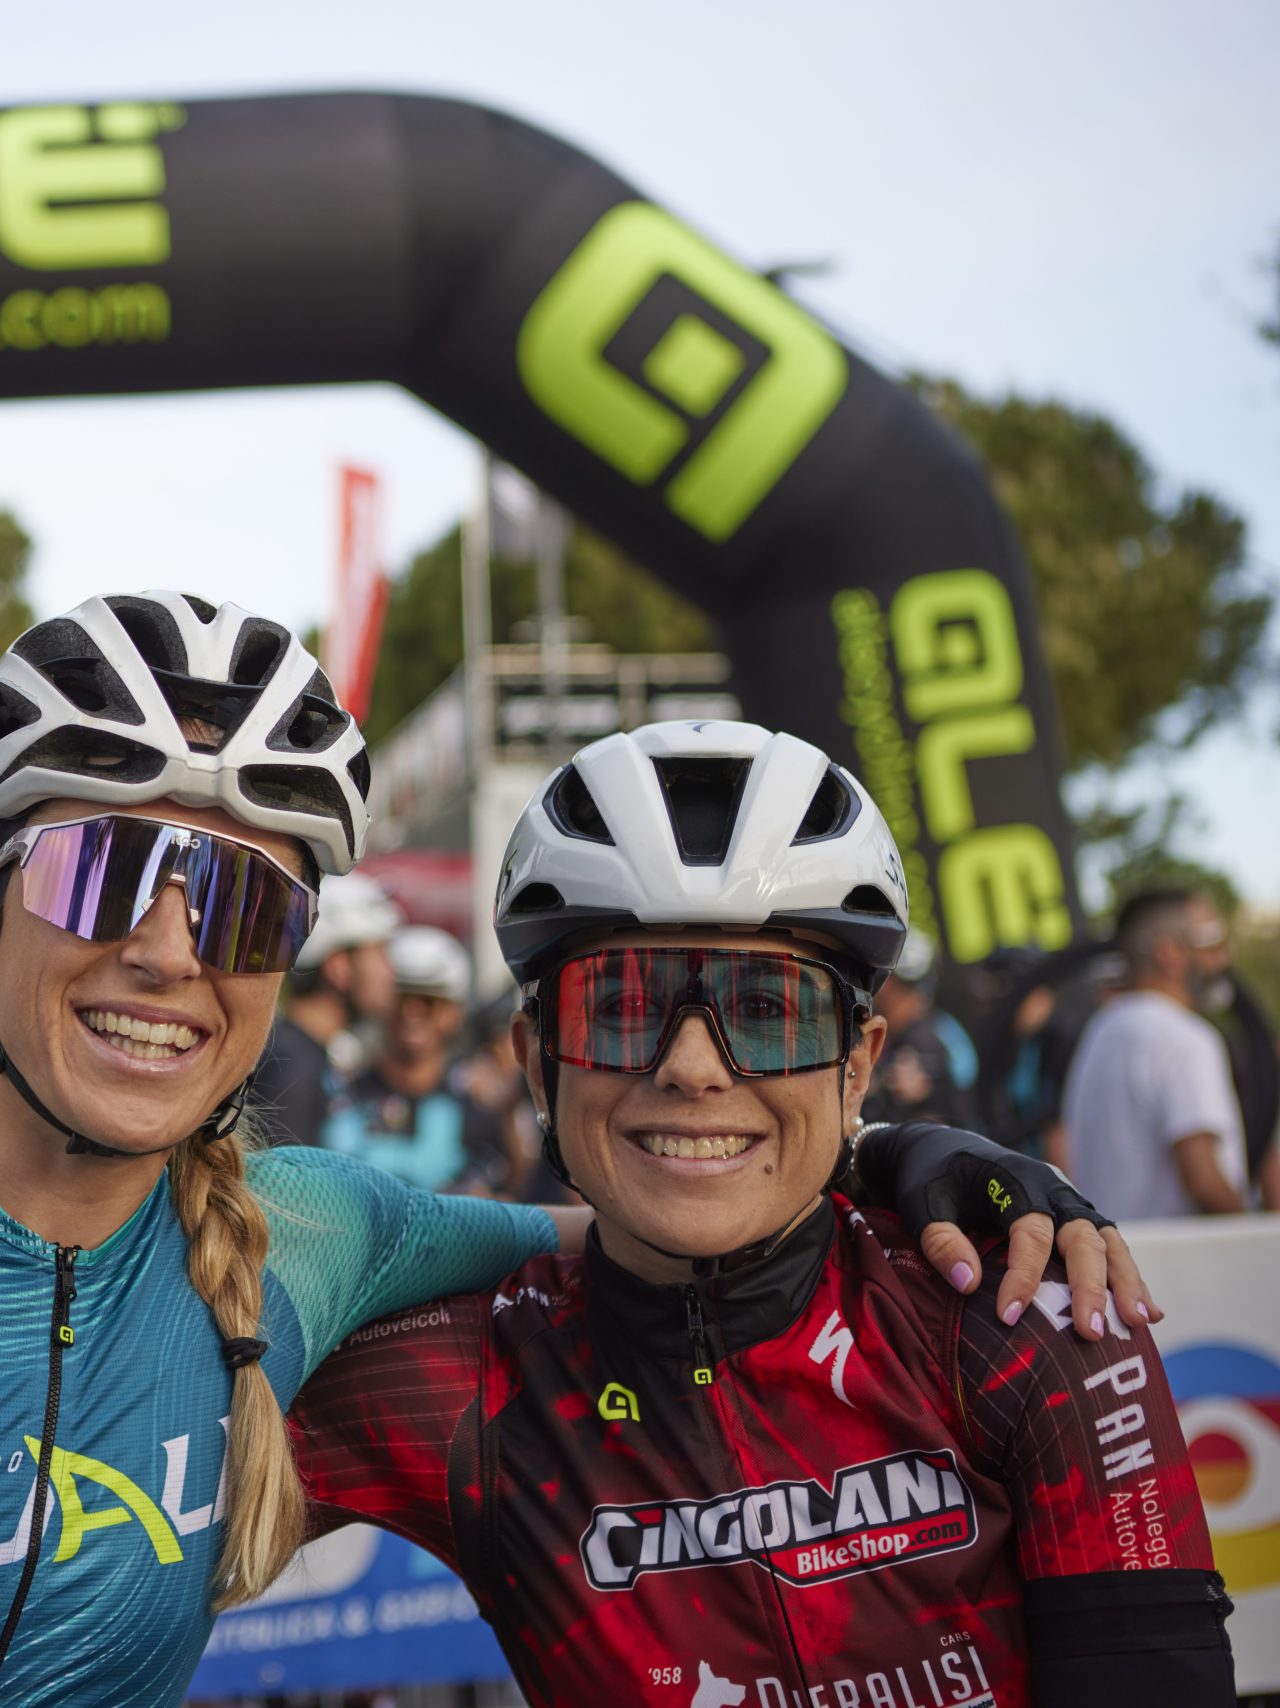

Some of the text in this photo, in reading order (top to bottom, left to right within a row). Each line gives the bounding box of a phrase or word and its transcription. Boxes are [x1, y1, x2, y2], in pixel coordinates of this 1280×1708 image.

[797, 1520, 963, 1576] BikeShop.com
[1138, 1478, 1179, 1569] Nolegg
[940, 1631, 972, 1647] CARS
